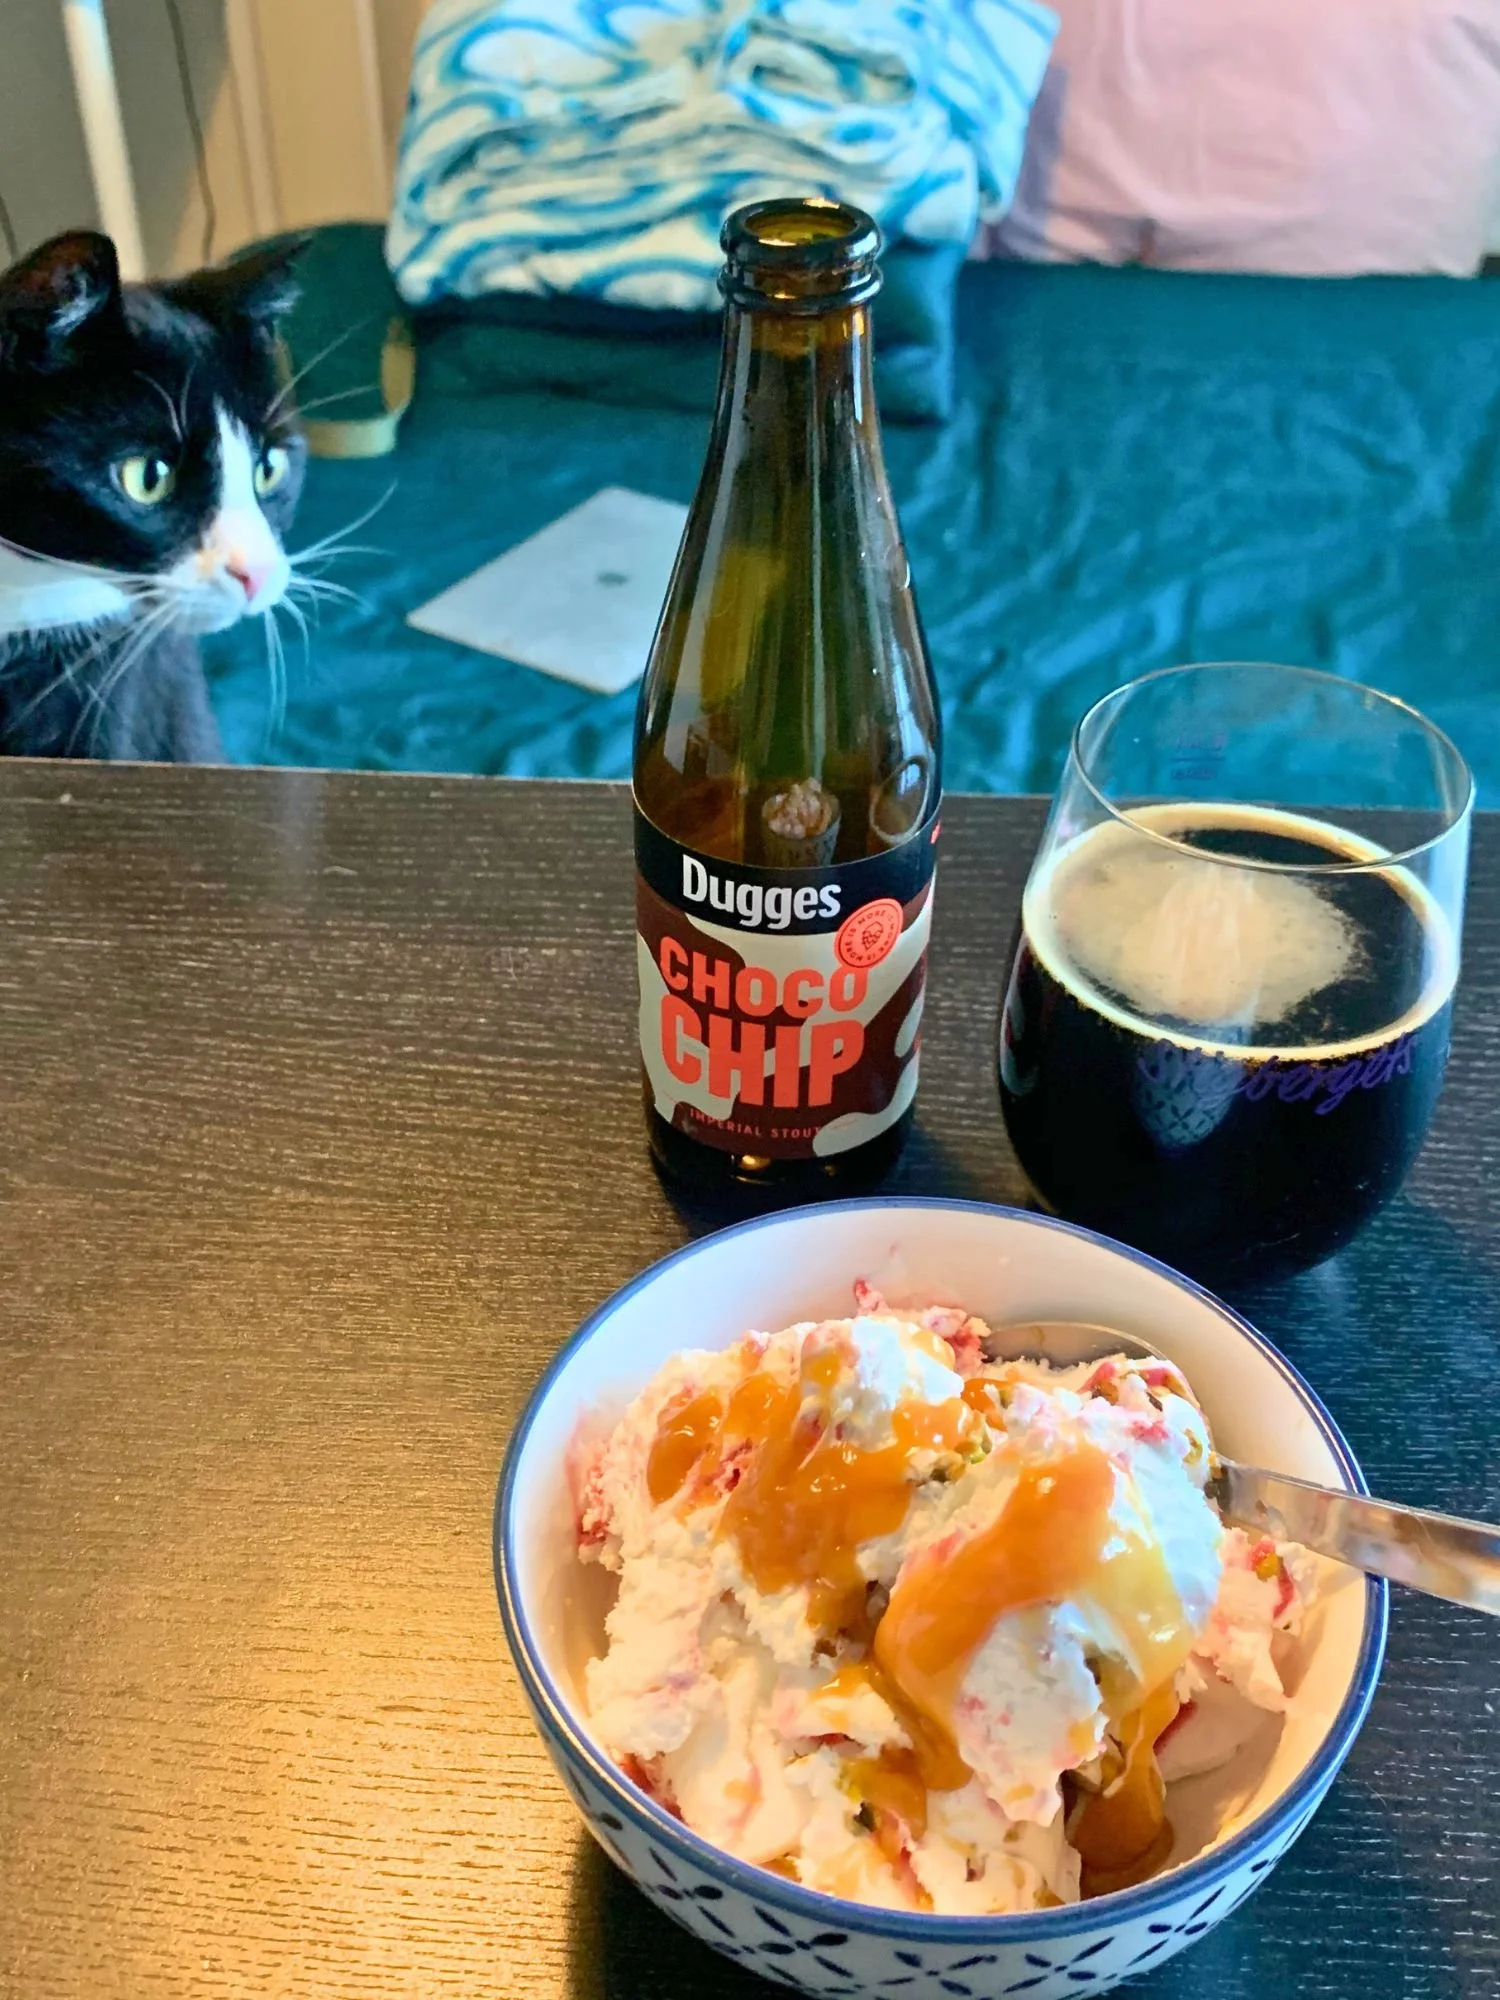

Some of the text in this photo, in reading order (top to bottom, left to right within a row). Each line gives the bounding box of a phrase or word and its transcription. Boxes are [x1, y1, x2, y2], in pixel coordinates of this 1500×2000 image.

[682, 853, 842, 930] Dugges
[660, 936, 869, 1018] CHOCO
[660, 993, 865, 1108] CHIP
[689, 1108, 762, 1137] IMPERIAL
